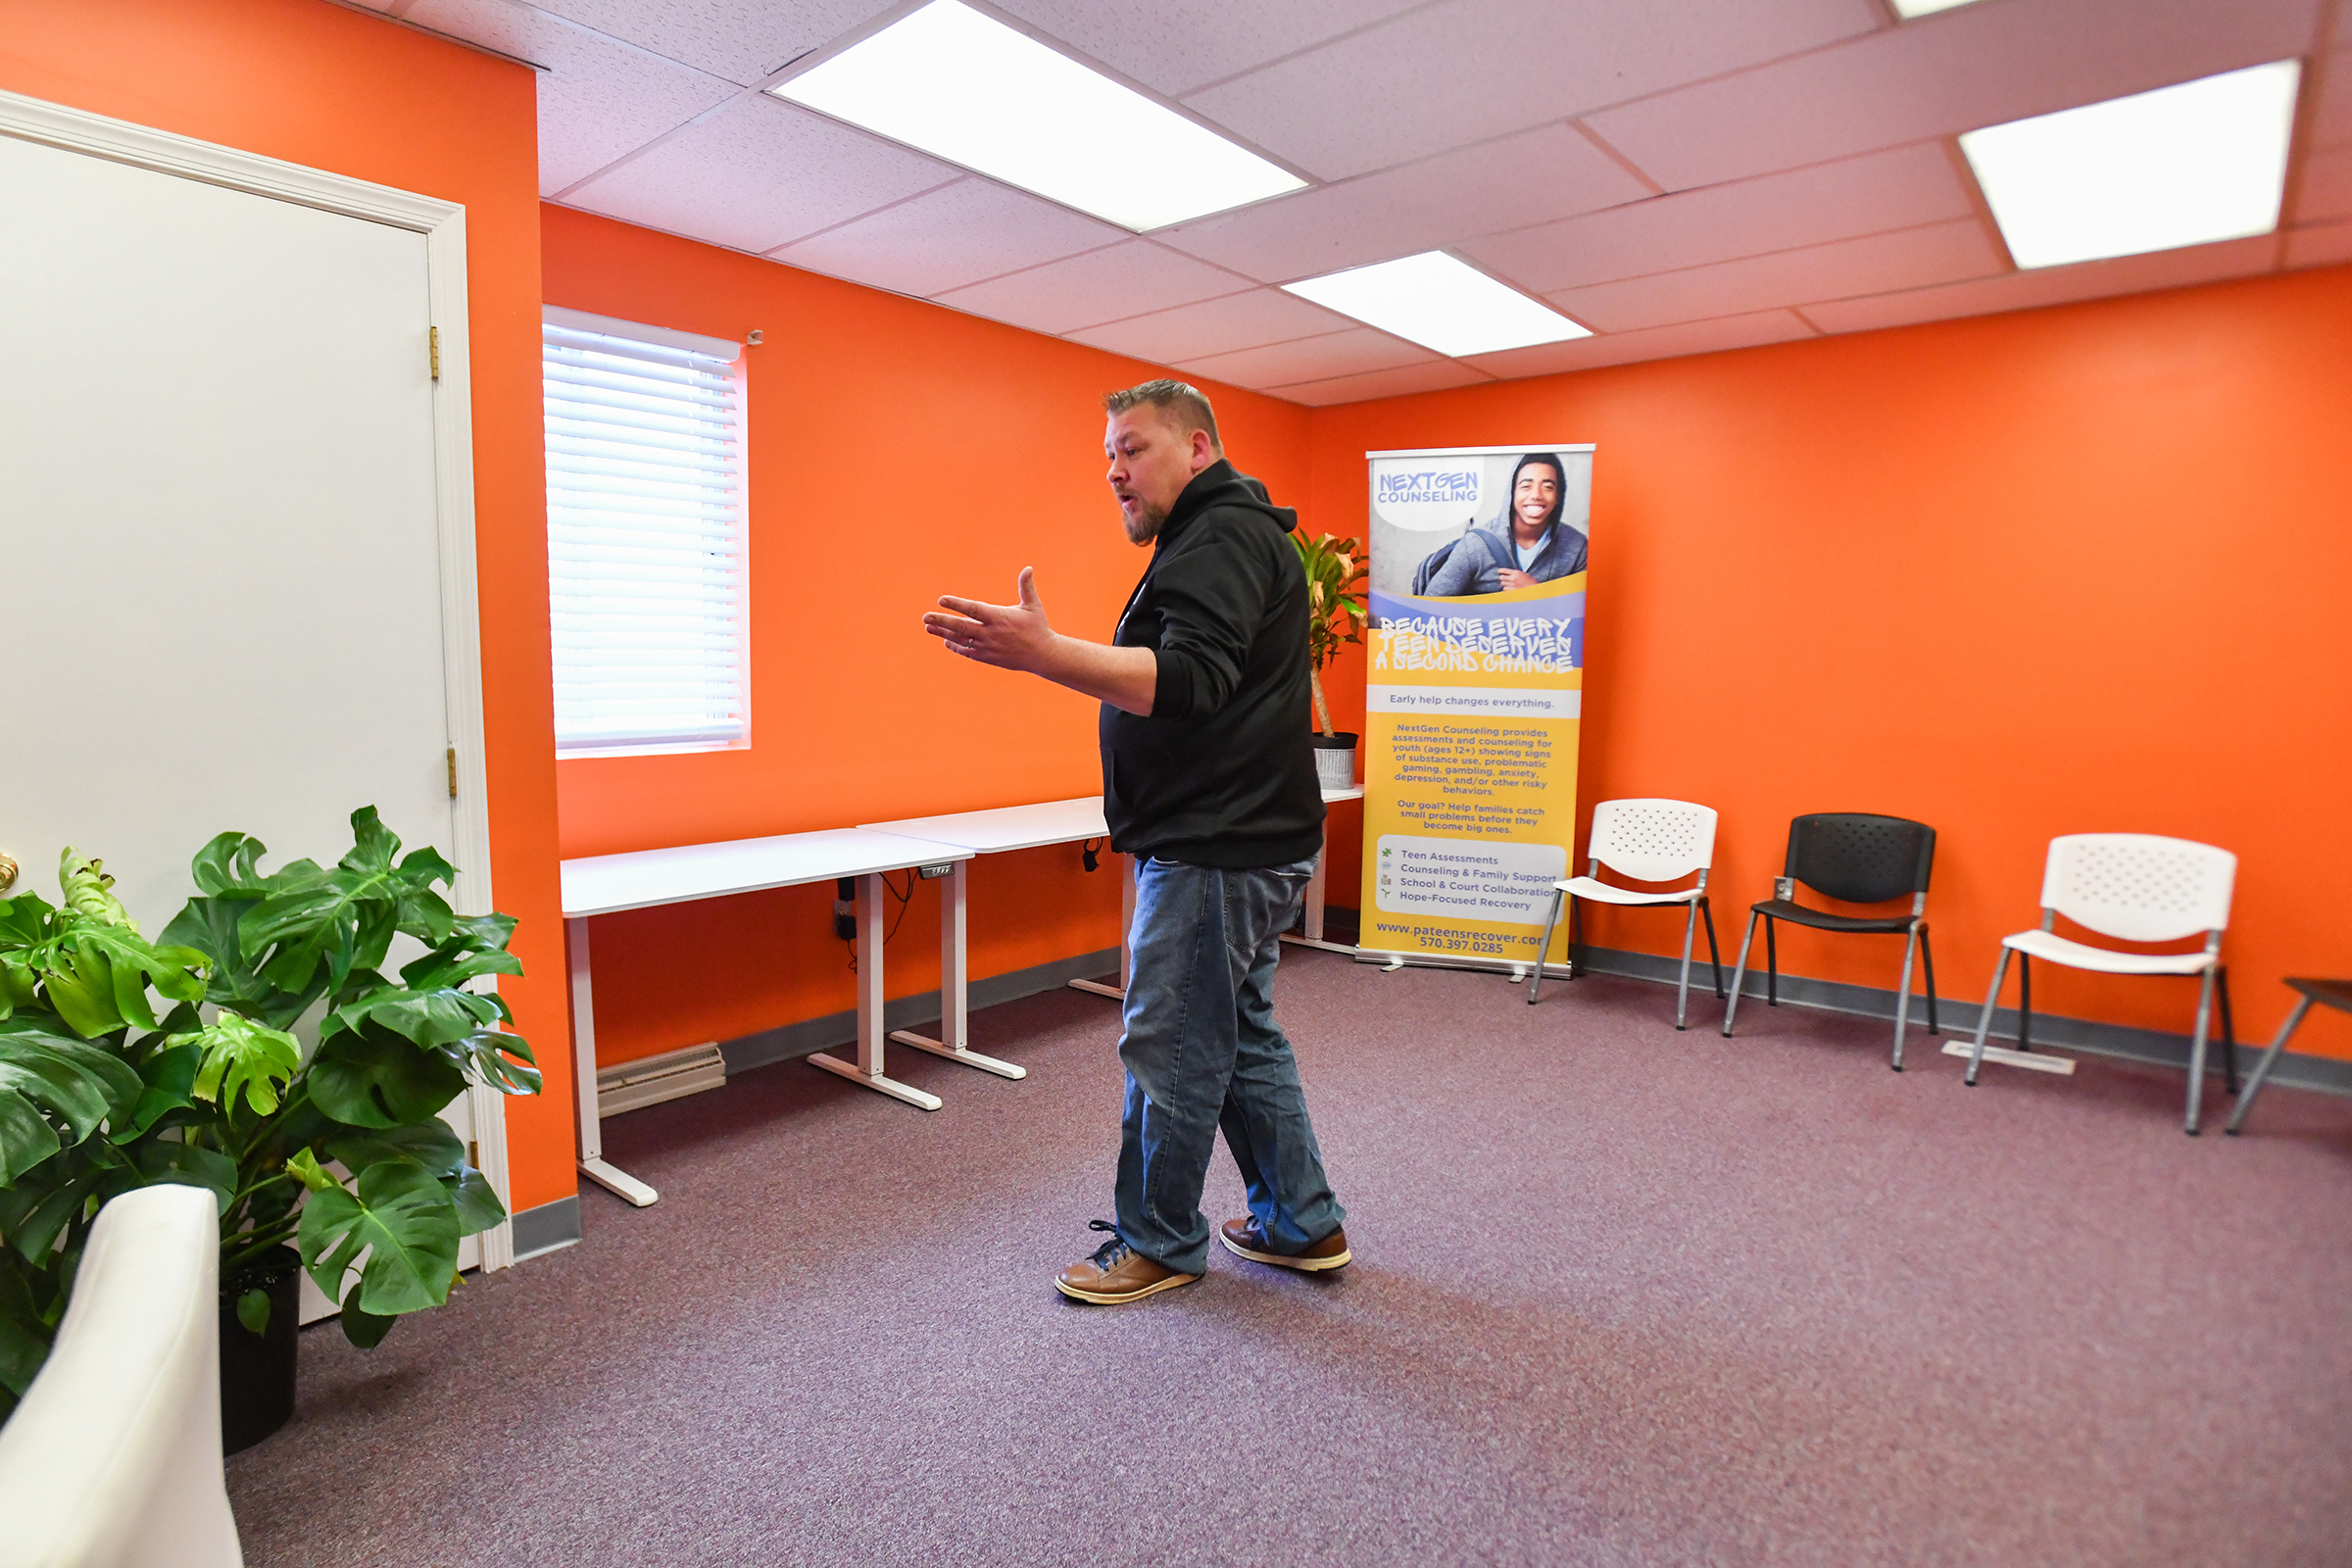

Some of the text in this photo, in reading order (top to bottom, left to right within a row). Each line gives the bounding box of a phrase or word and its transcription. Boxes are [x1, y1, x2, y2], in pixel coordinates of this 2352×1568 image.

[1381, 472, 1478, 491] NEXTGEN
[1378, 491, 1477, 503] COUNSELING
[1380, 616, 1571, 637] BECAUSE EVERY
[1378, 630, 1571, 656] TEEN DESERVES
[1375, 651, 1574, 674] A SECOND CHANCE
[1390, 695, 1554, 709] Early help changes everything.
[1397, 724, 1547, 738] NextGen Counseling provides
[1479, 738, 1534, 748] counseling
[1393, 745, 1550, 759] youth (ages 12+) showing signs
[1409, 755, 1458, 763] substance
[1485, 759, 1546, 768] problematic
[1402, 764, 1539, 778] gaming, gambling, anxiety,
[1395, 774, 1450, 783] depression,
[1454, 777, 1488, 786] and/or
[1523, 780, 1546, 790] risky
[1444, 786, 1494, 795] behaviors.
[1419, 802, 1446, 810] goal?
[1448, 804, 1471, 812] Help
[1475, 805, 1513, 813] families
[1429, 811, 1475, 821] problems
[1515, 817, 1538, 826] they
[1424, 821, 1463, 830] become
[1467, 824, 1482, 833] big
[1402, 850, 1498, 864] Teen Assessments
[1401, 864, 1557, 883] Counseling & Family Support
[1400, 878, 1436, 888] School
[1450, 882, 1479, 892] Court
[1400, 892, 1531, 910] Hope-Focused Recovery
[1421, 937, 1503, 954] 570.397.0285
